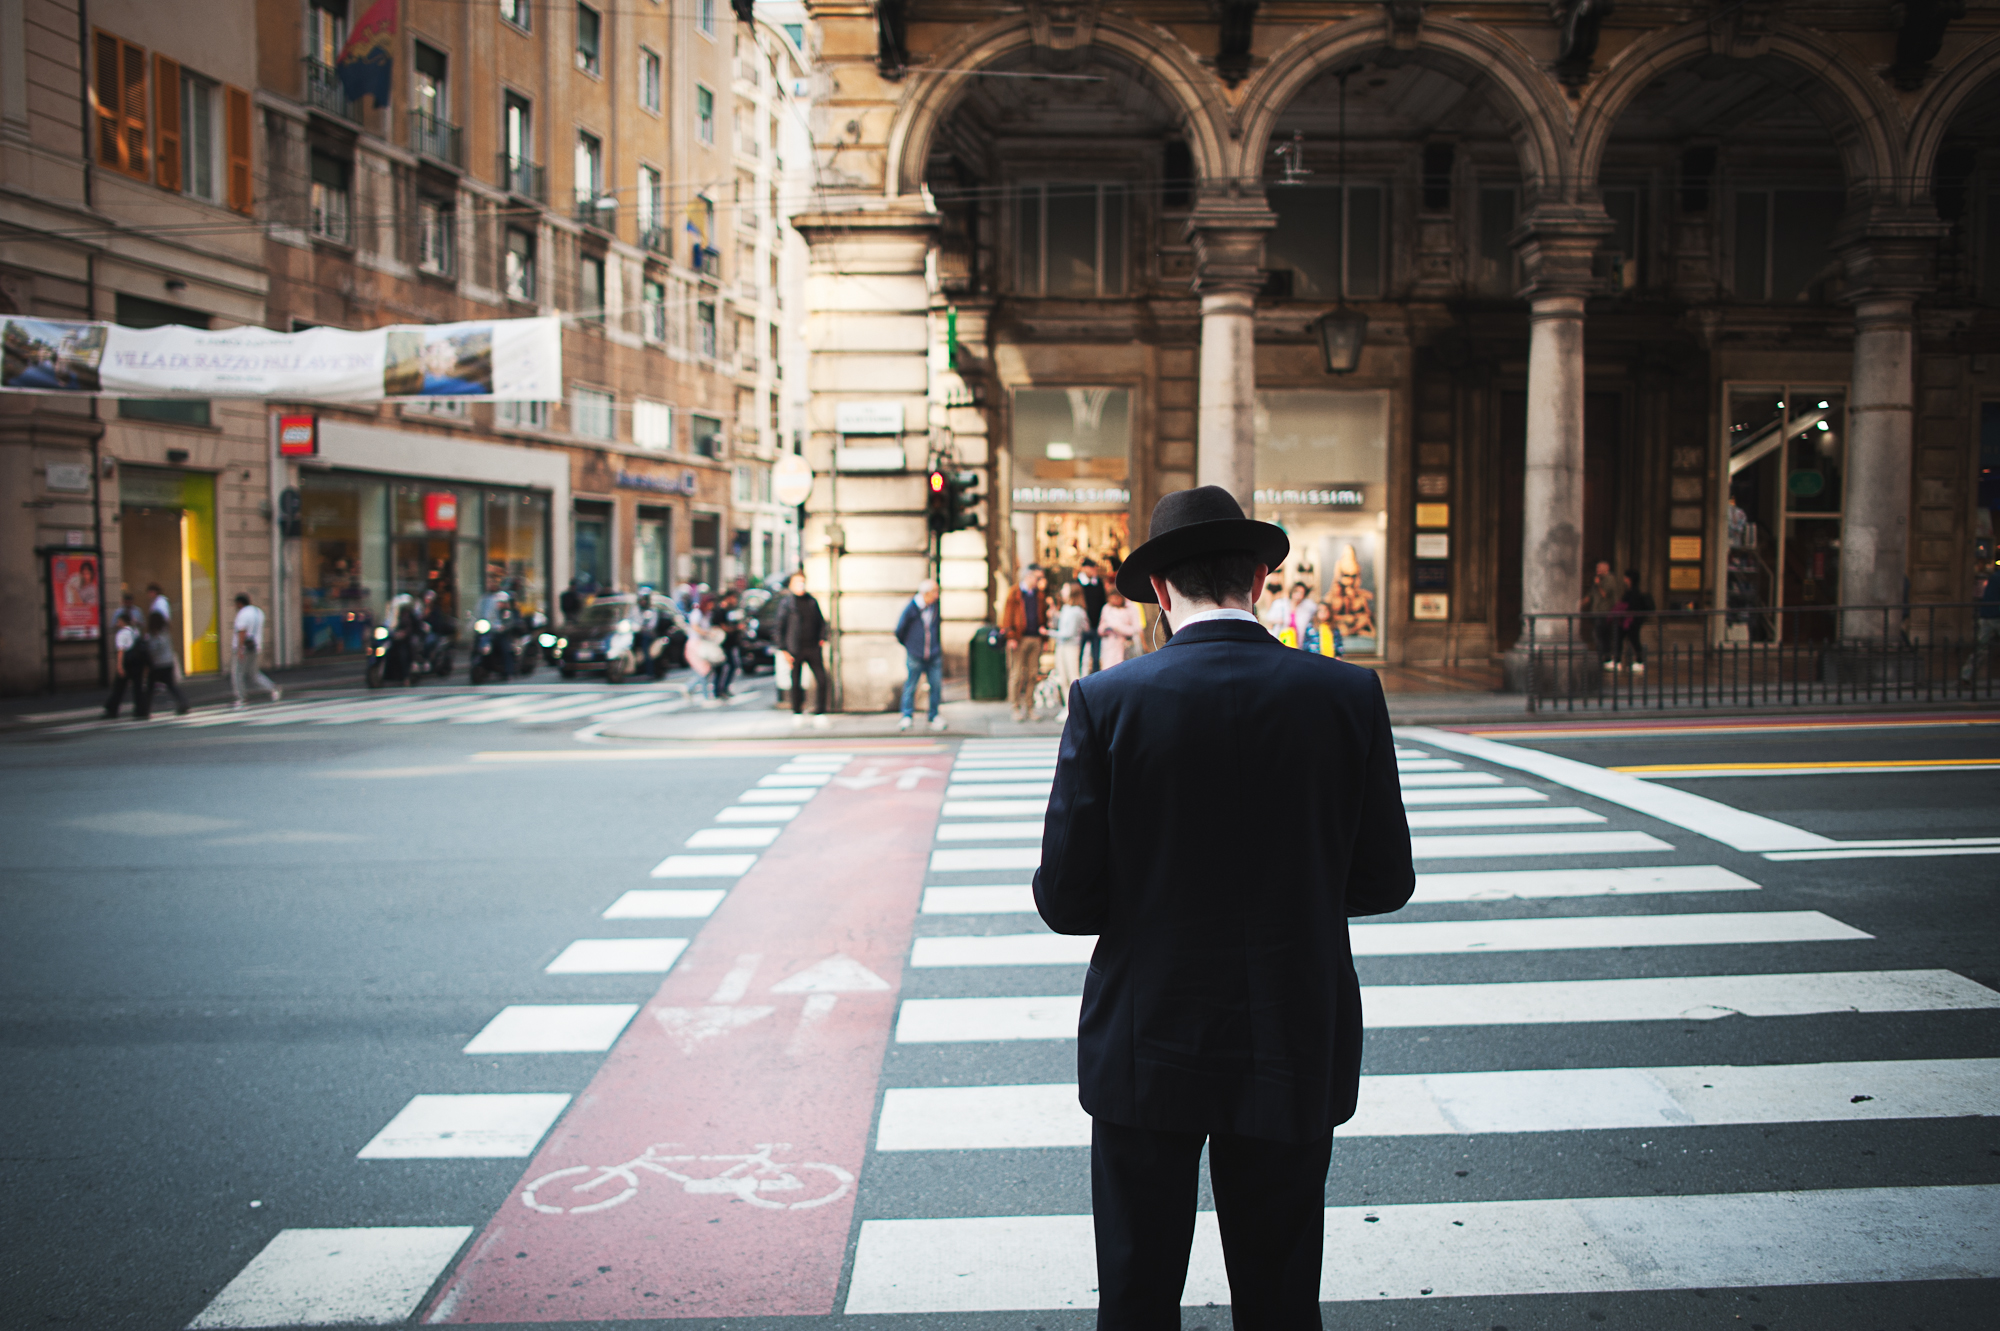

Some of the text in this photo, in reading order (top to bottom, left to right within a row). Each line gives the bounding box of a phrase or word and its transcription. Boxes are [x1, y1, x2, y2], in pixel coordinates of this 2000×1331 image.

[114, 350, 167, 369] VILLA
[1013, 486, 1130, 503] intimissimi
[1254, 488, 1363, 505] ntimissimi
